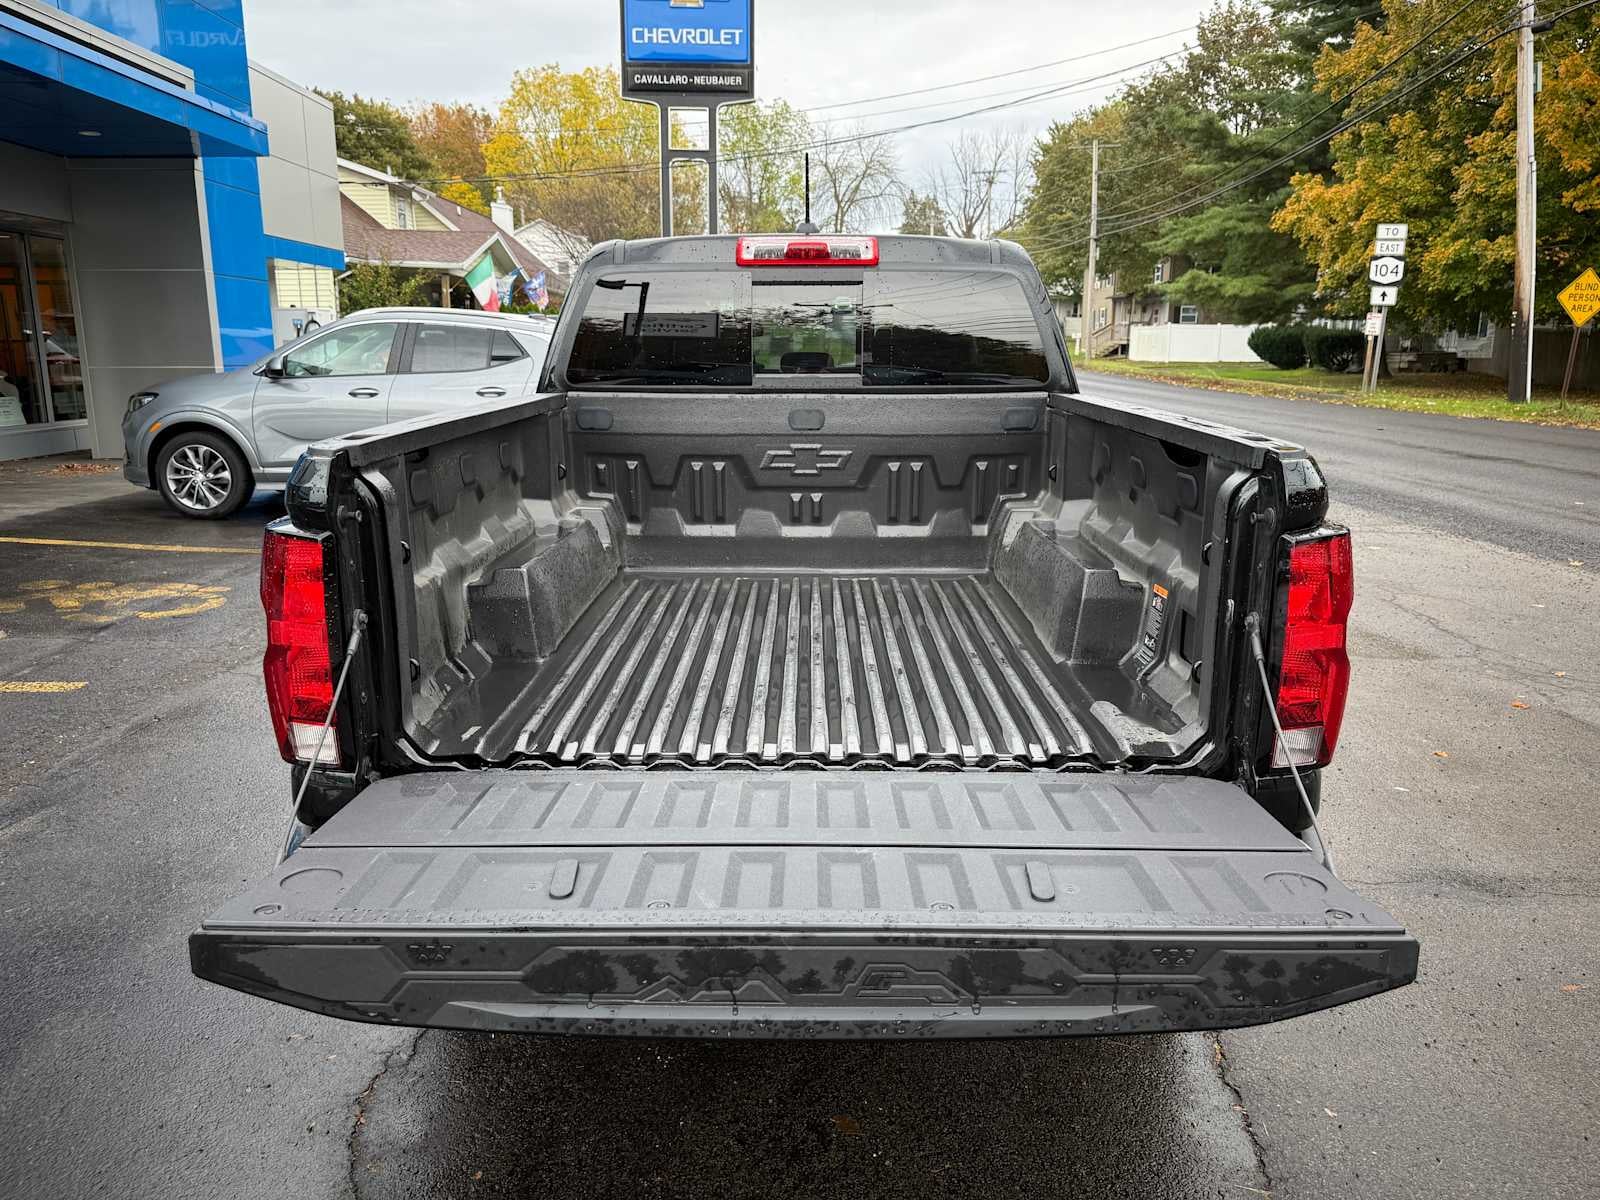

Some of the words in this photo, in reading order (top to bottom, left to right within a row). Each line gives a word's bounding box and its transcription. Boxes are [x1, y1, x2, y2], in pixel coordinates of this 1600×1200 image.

[631, 27, 743, 45] CHEVROLET
[634, 74, 742, 86] CAVALLARO-NEUBAUER
[1385, 227, 1399, 236] TO
[1380, 243, 1400, 253] EAST
[1375, 264, 1399, 277] 104
[1575, 282, 1599, 291] BLIND
[1568, 293, 1600, 302] PERSON
[1571, 304, 1593, 313] AREA
